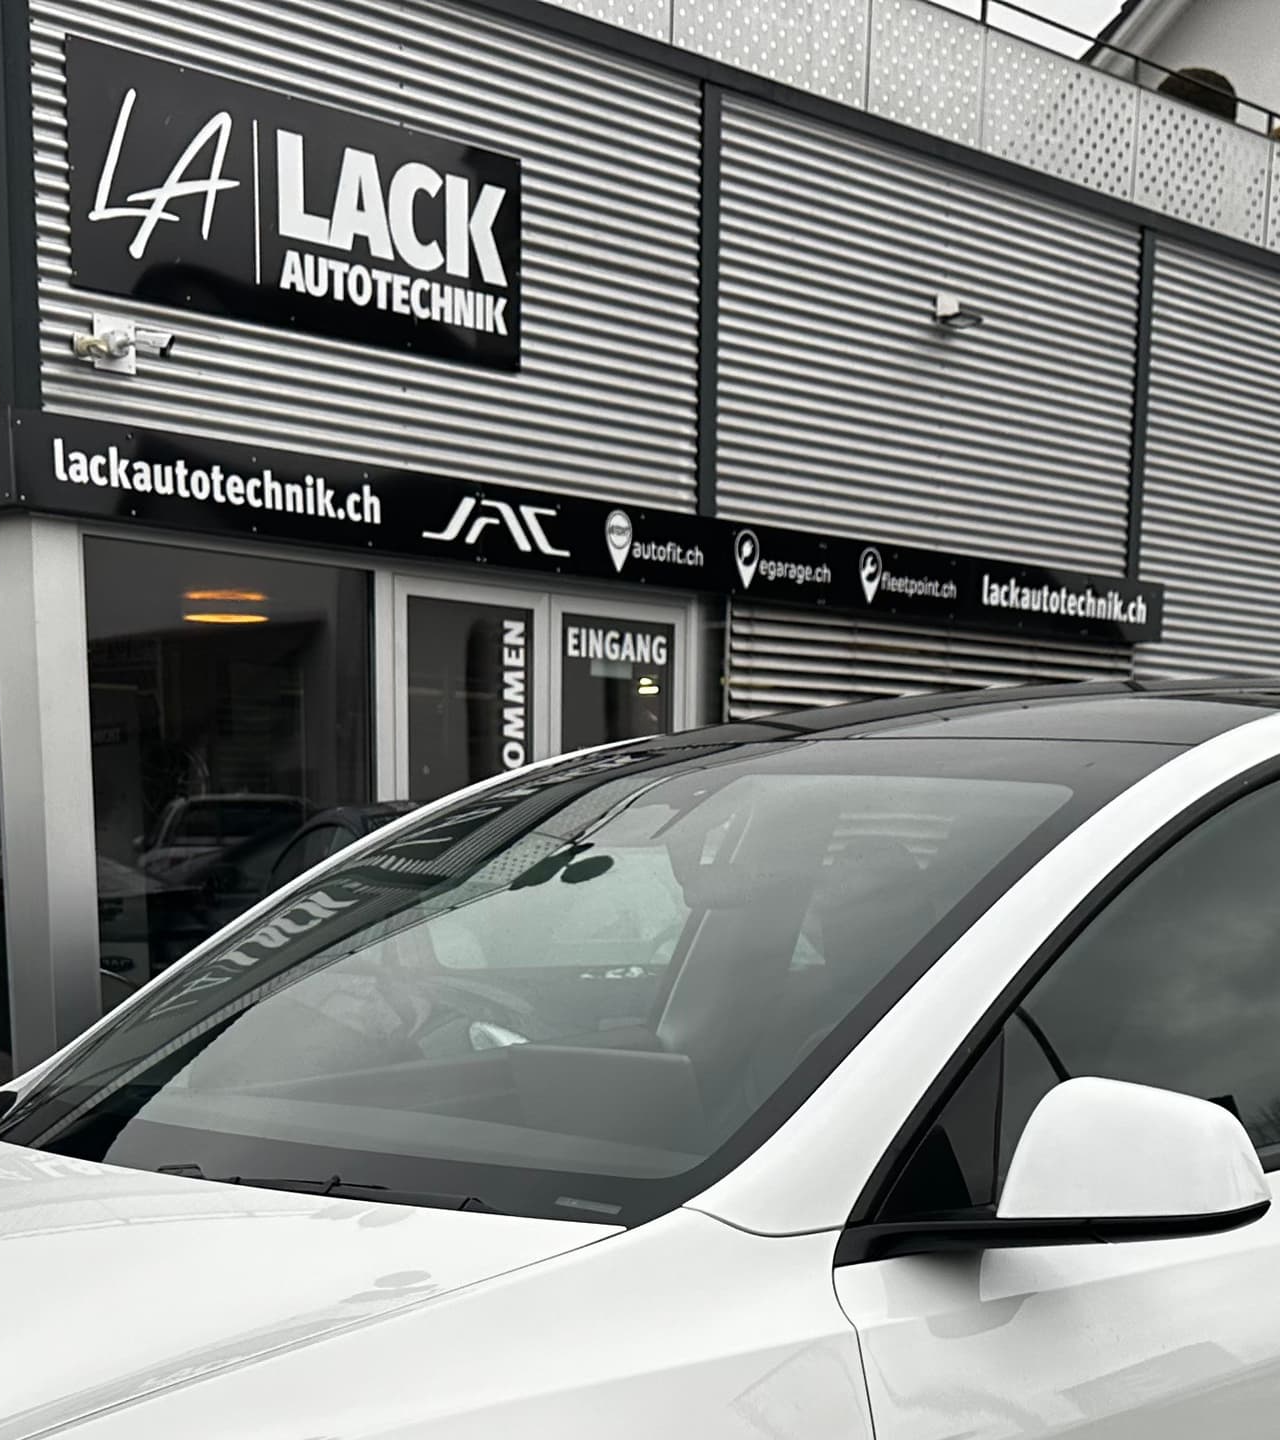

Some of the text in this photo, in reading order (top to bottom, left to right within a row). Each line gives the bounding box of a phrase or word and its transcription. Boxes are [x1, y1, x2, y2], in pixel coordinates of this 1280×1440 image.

[276, 129, 508, 287] LACK
[279, 250, 508, 336] AUTOTECHNIK
[53, 438, 382, 525] lackautotechnik.ch
[632, 541, 705, 567] autofit.ch
[758, 557, 832, 585] egarage.ch
[880, 570, 958, 600] fleetpoint.ch
[982, 573, 1147, 625] lackautotechnik.ch
[567, 626, 668, 666] EINGANG
[503, 620, 526, 770] OMMEN
